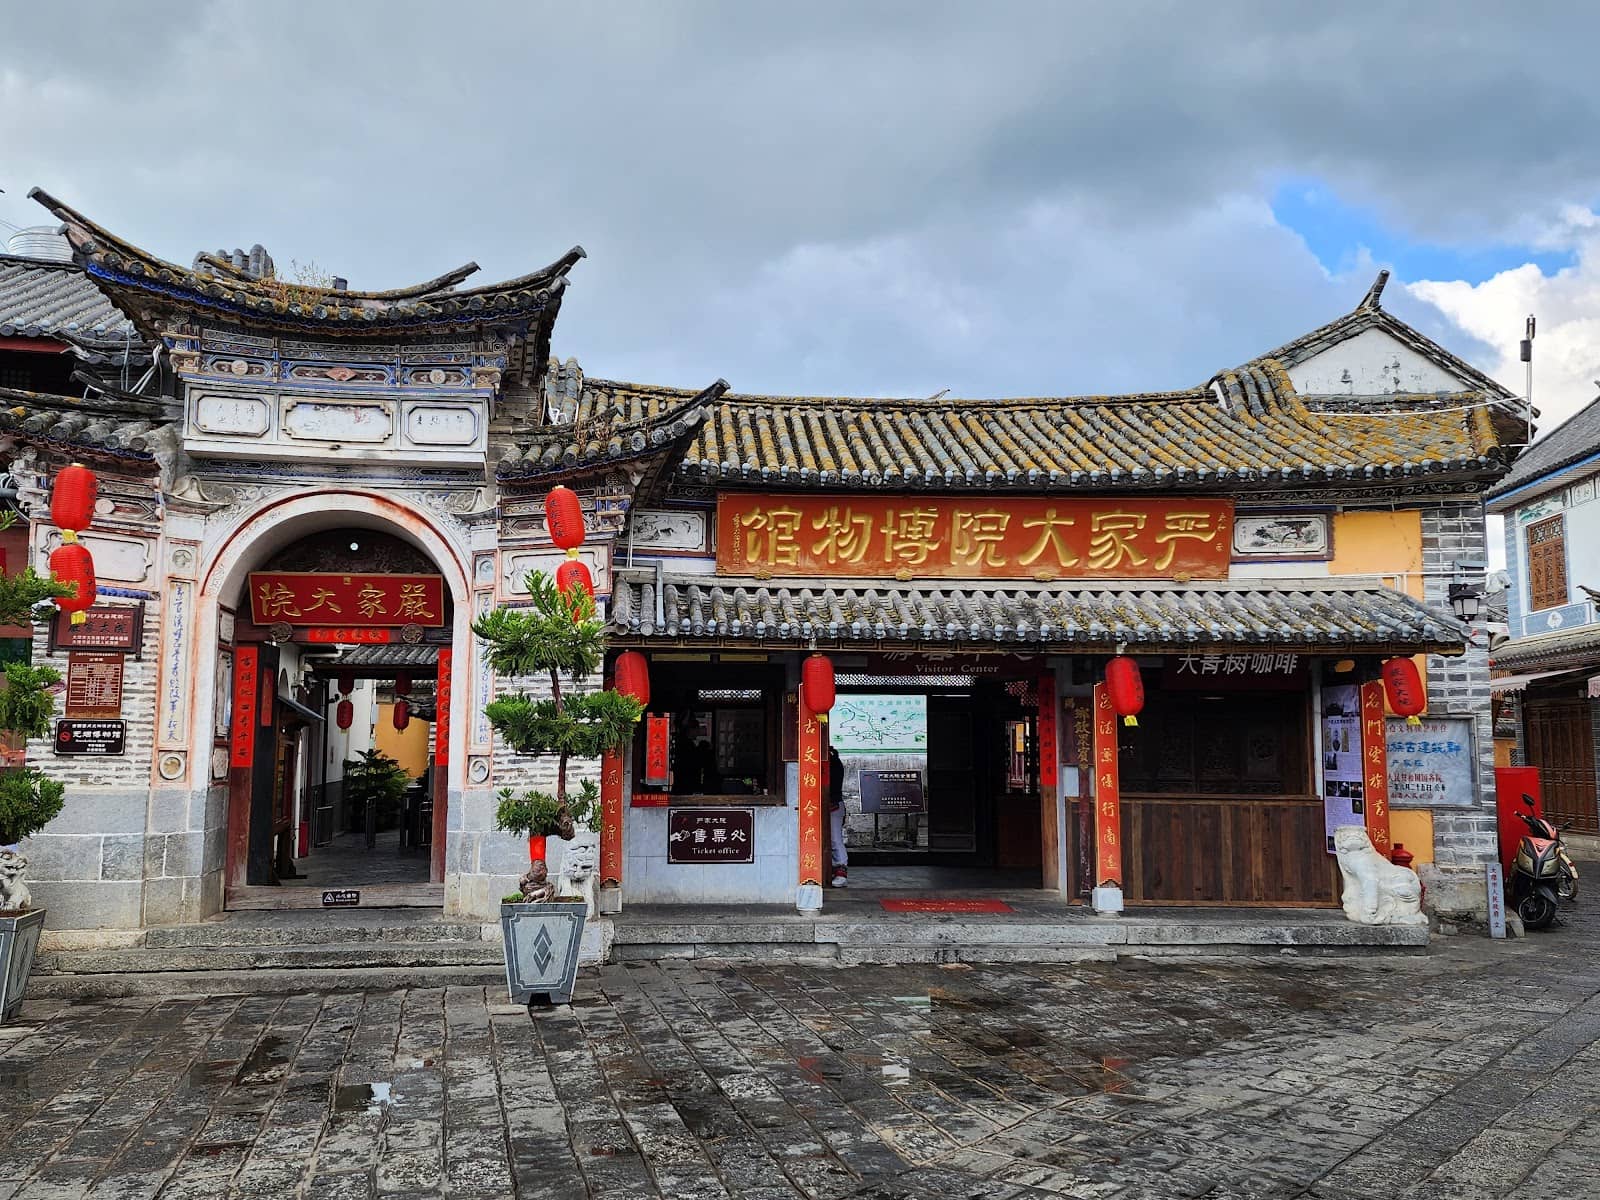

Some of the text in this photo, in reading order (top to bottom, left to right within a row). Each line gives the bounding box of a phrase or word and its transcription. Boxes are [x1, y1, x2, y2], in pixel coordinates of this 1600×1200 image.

[916, 664, 999, 673] Visitor Center
[1177, 653, 1298, 675] 大青树咖啡
[692, 828, 747, 843] 售票处
[692, 847, 740, 855] Ticket office
